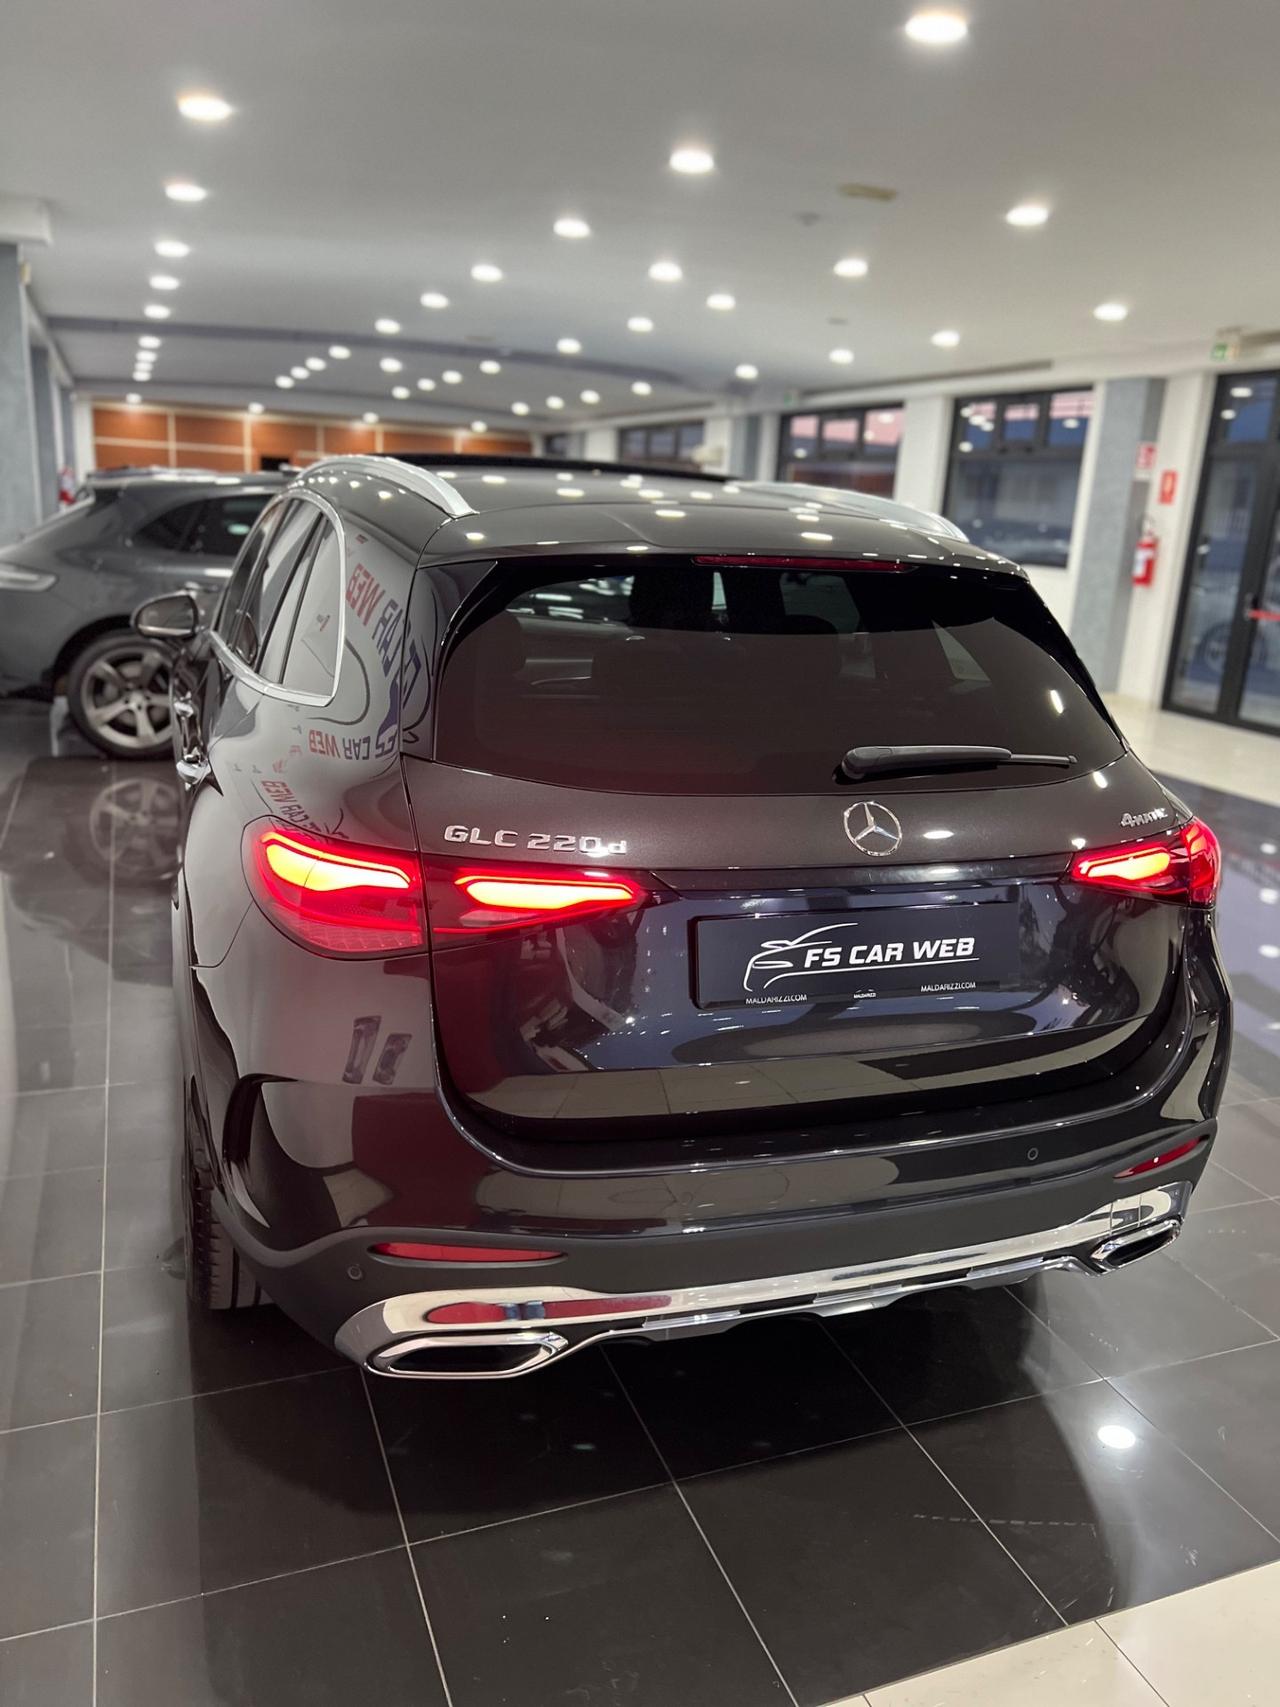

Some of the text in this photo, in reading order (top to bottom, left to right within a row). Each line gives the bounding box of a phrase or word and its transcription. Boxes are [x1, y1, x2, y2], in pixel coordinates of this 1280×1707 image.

[308, 729, 341, 758] WEB
[342, 735, 371, 760] CAR
[443, 824, 519, 847] GLC
[804, 937, 975, 968] FS CAR WEB
[920, 981, 977, 993] MALDARIZZI.COM
